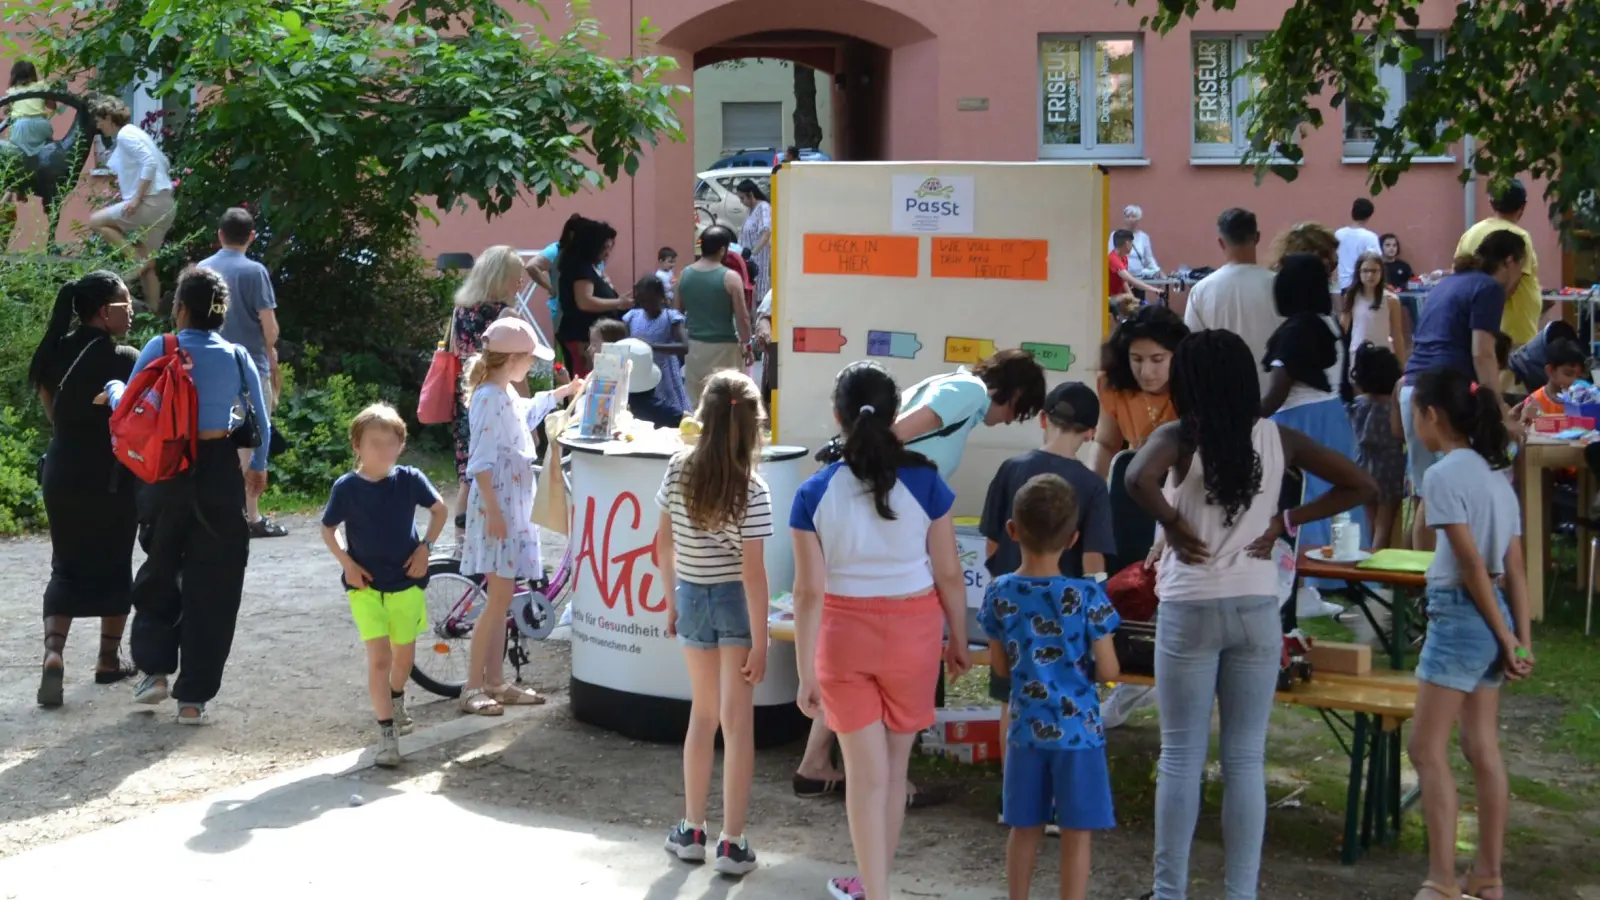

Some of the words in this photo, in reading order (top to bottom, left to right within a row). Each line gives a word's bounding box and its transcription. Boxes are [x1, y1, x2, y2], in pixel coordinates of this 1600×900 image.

[1048, 41, 1066, 122] FRISEUR
[1199, 41, 1217, 122] FRISEUR
[1219, 79, 1230, 122] Sieglinde
[906, 198, 960, 216] PasSt
[819, 239, 858, 254] CHECK
[864, 240, 878, 253] IN
[940, 241, 960, 253] WIE
[967, 242, 994, 253] VOLL
[838, 255, 869, 272] HIER
[964, 570, 983, 588] St
[585, 612, 596, 627] für
[598, 615, 660, 638] Gesundheit
